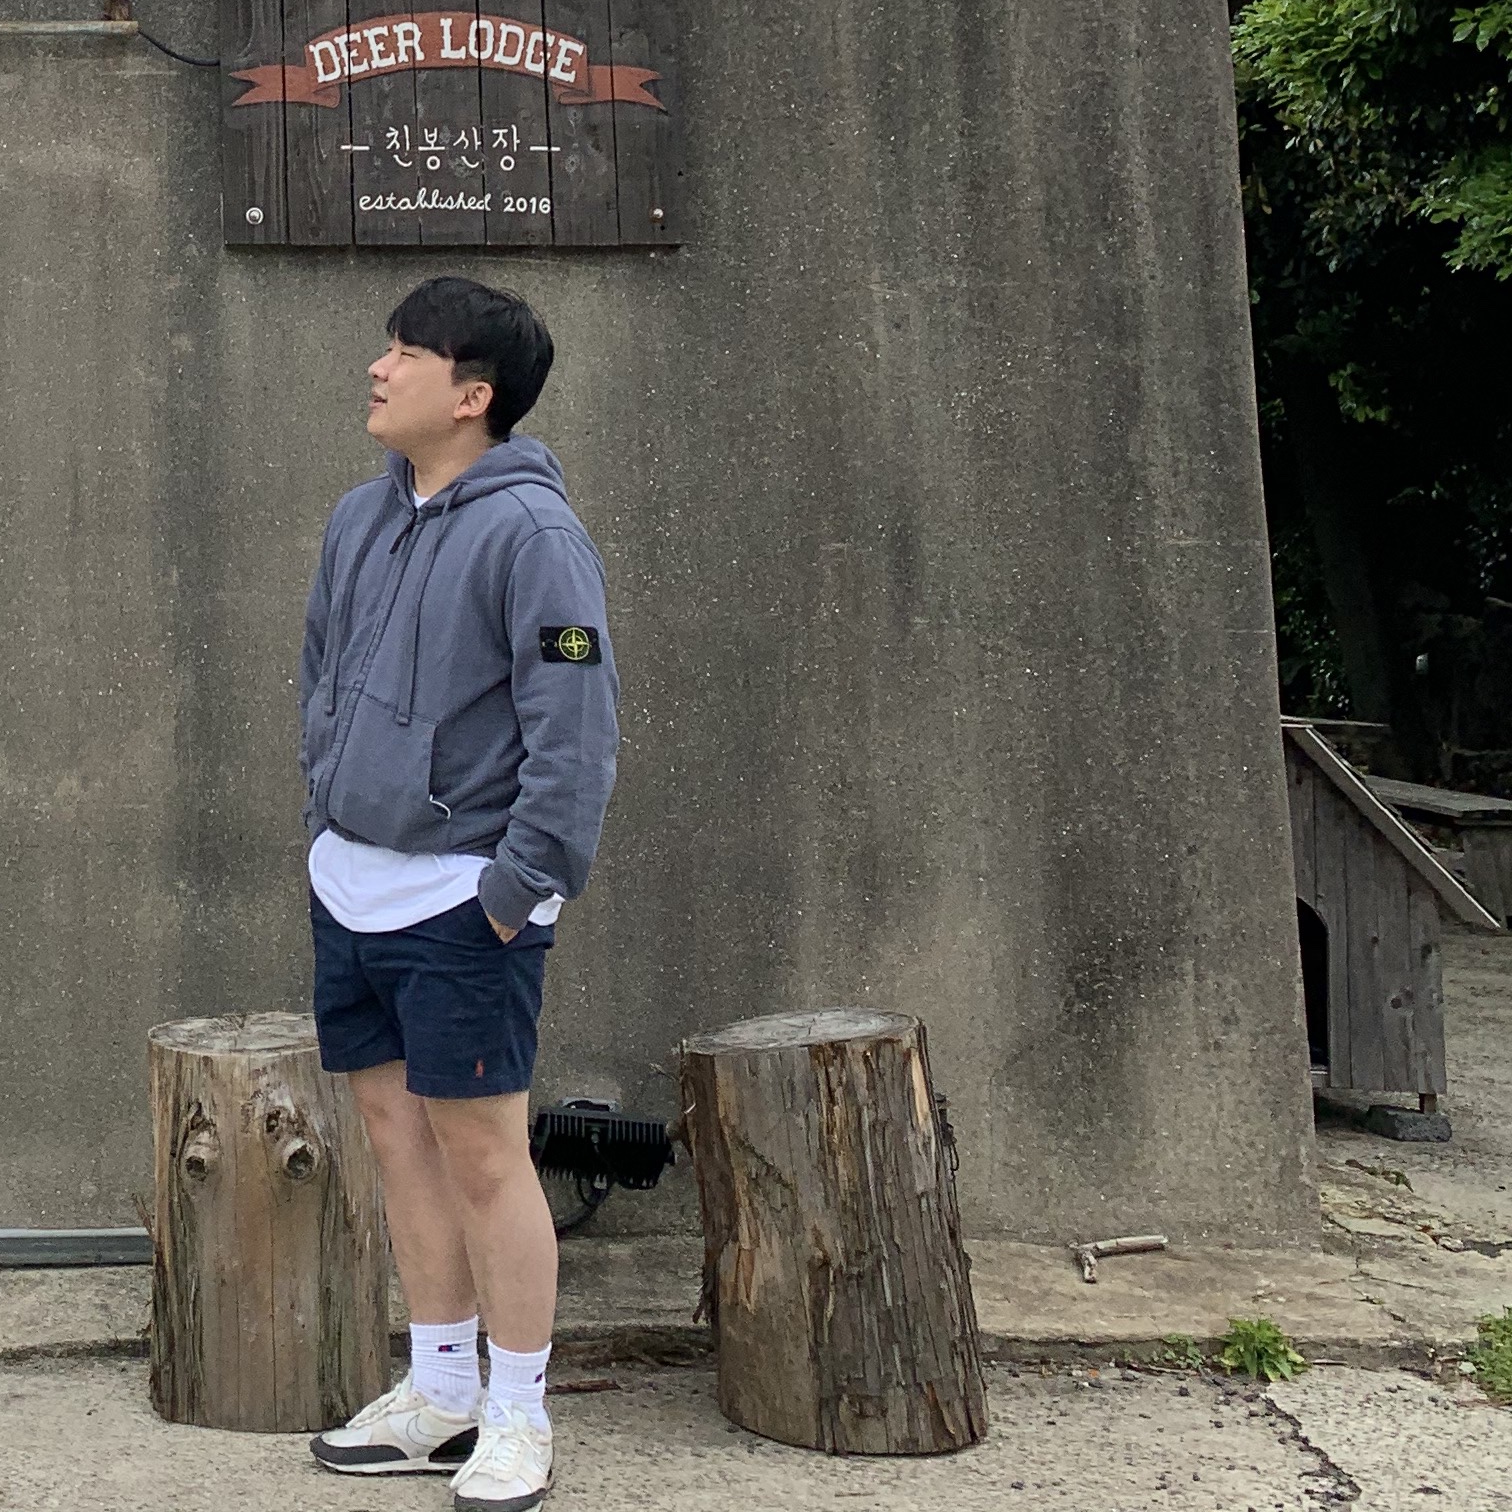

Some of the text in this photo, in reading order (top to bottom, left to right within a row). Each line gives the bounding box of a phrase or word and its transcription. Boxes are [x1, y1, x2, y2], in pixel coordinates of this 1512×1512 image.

[308, 17, 586, 84] DEER LODGE
[385, 123, 522, 172] 친봉산장
[358, 187, 552, 215] established 2016
